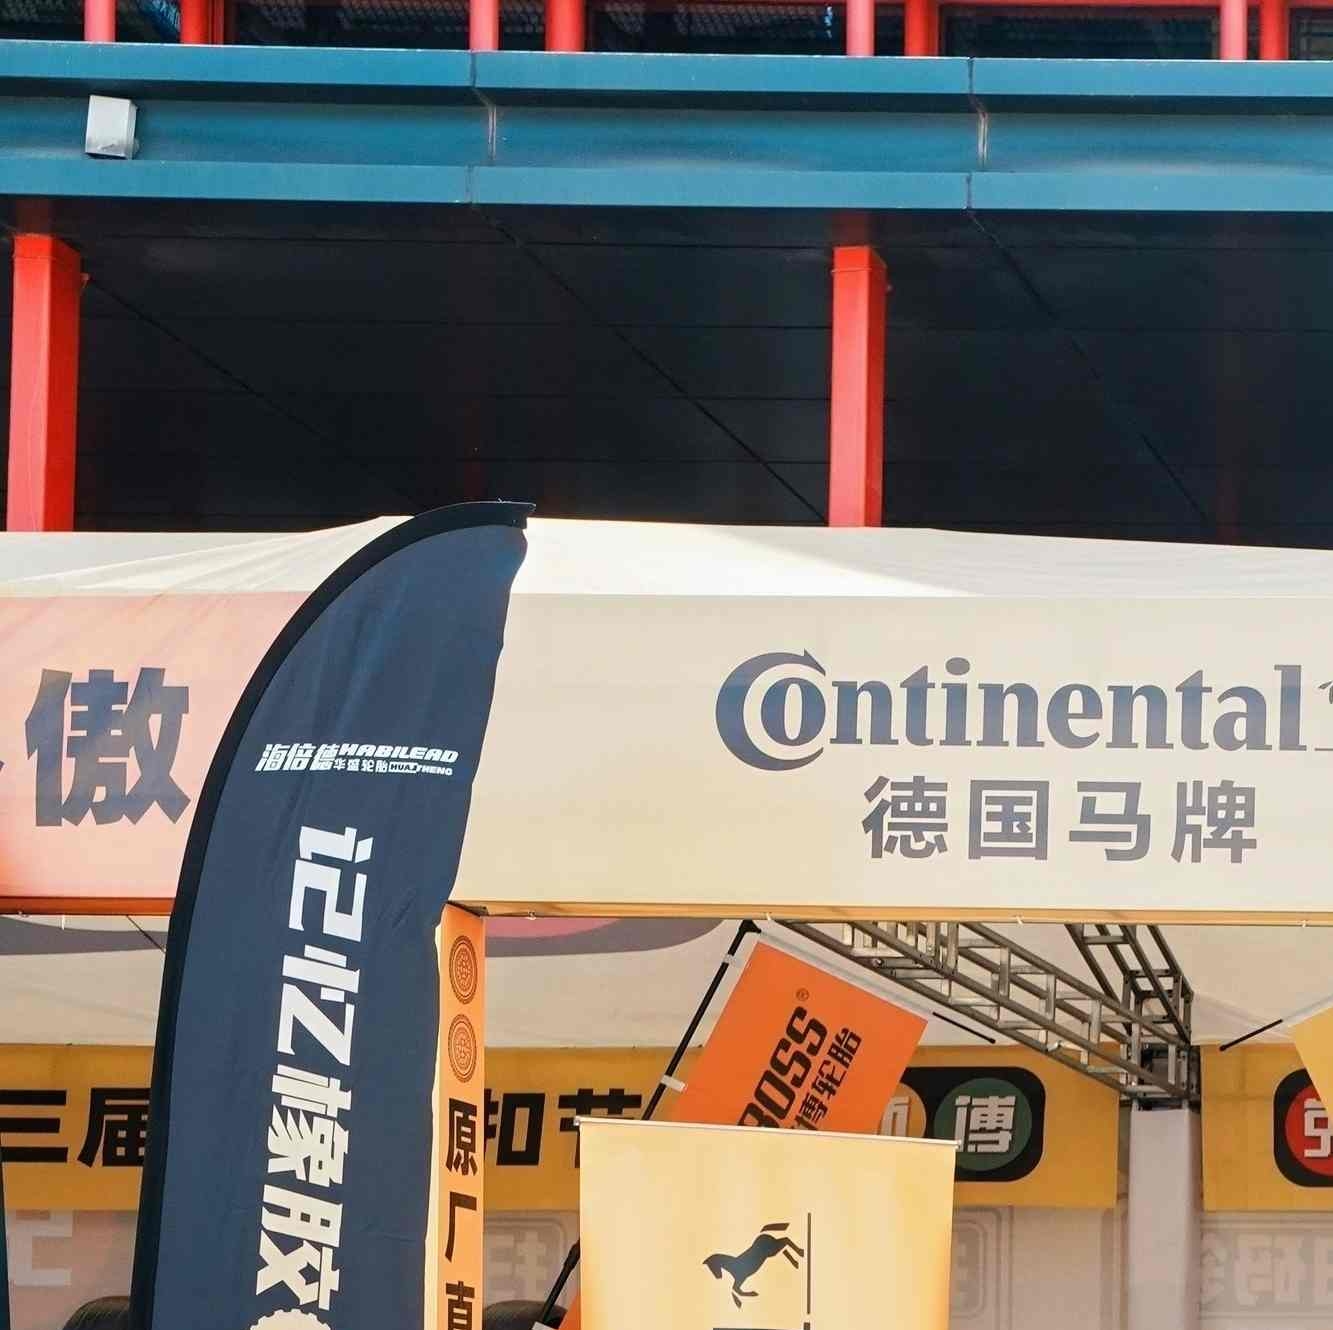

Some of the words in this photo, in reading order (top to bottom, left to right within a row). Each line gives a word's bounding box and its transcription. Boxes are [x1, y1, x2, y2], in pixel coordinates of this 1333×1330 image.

[0, 667, 192, 827] 傲
[338, 743, 460, 763] HABILEAD
[715, 648, 1307, 771] Continental
[861, 775, 1258, 863] 德国马牌
[256, 825, 374, 1312] 记忆橡胶
